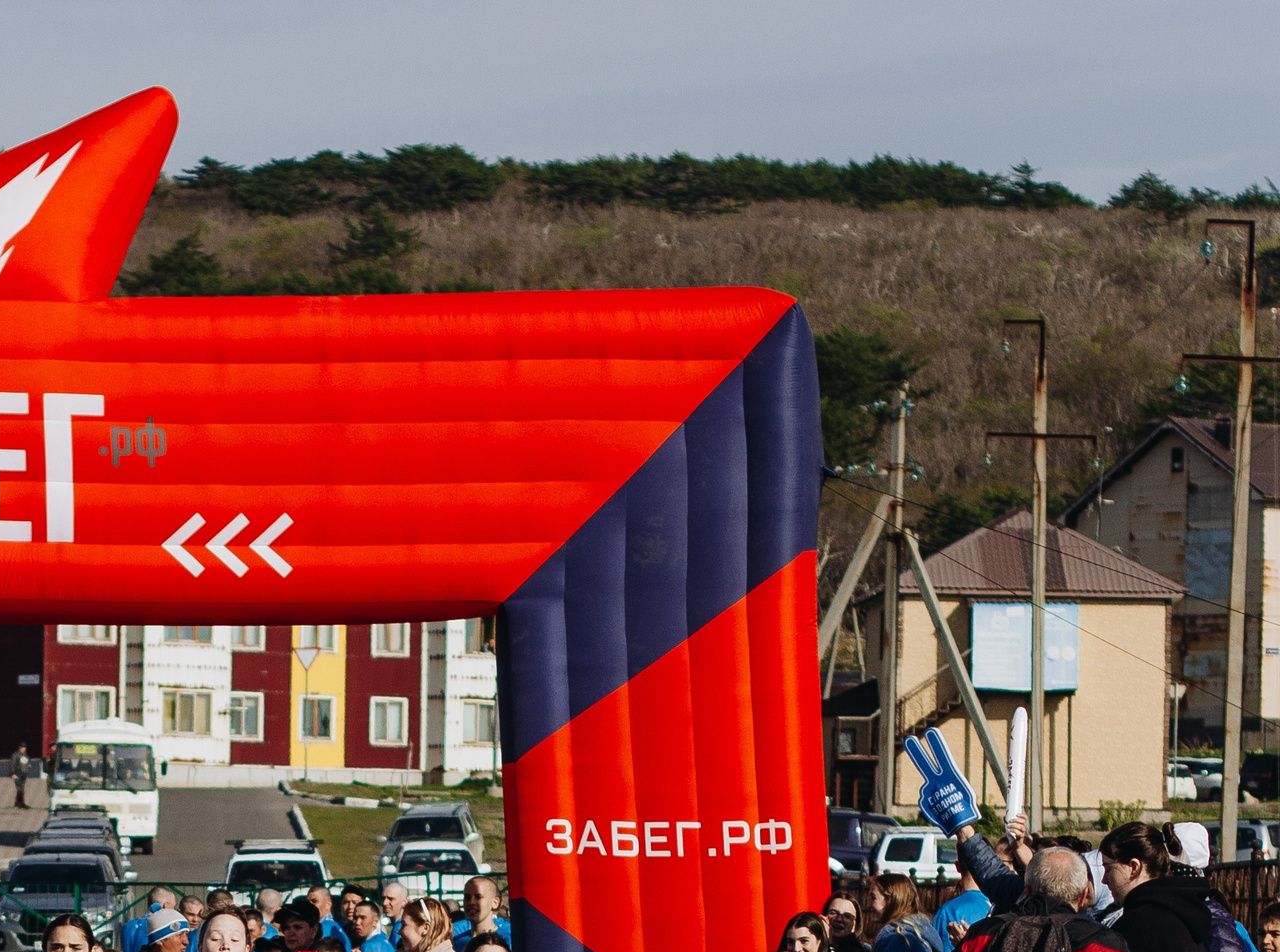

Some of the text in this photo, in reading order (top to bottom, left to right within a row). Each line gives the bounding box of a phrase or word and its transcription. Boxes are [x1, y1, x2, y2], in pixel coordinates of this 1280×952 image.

[927, 783, 957, 806] СТРАНА
[941, 802, 966, 822] РИТМЕ
[545, 818, 793, 858] ЗАБЕГ.РФ
